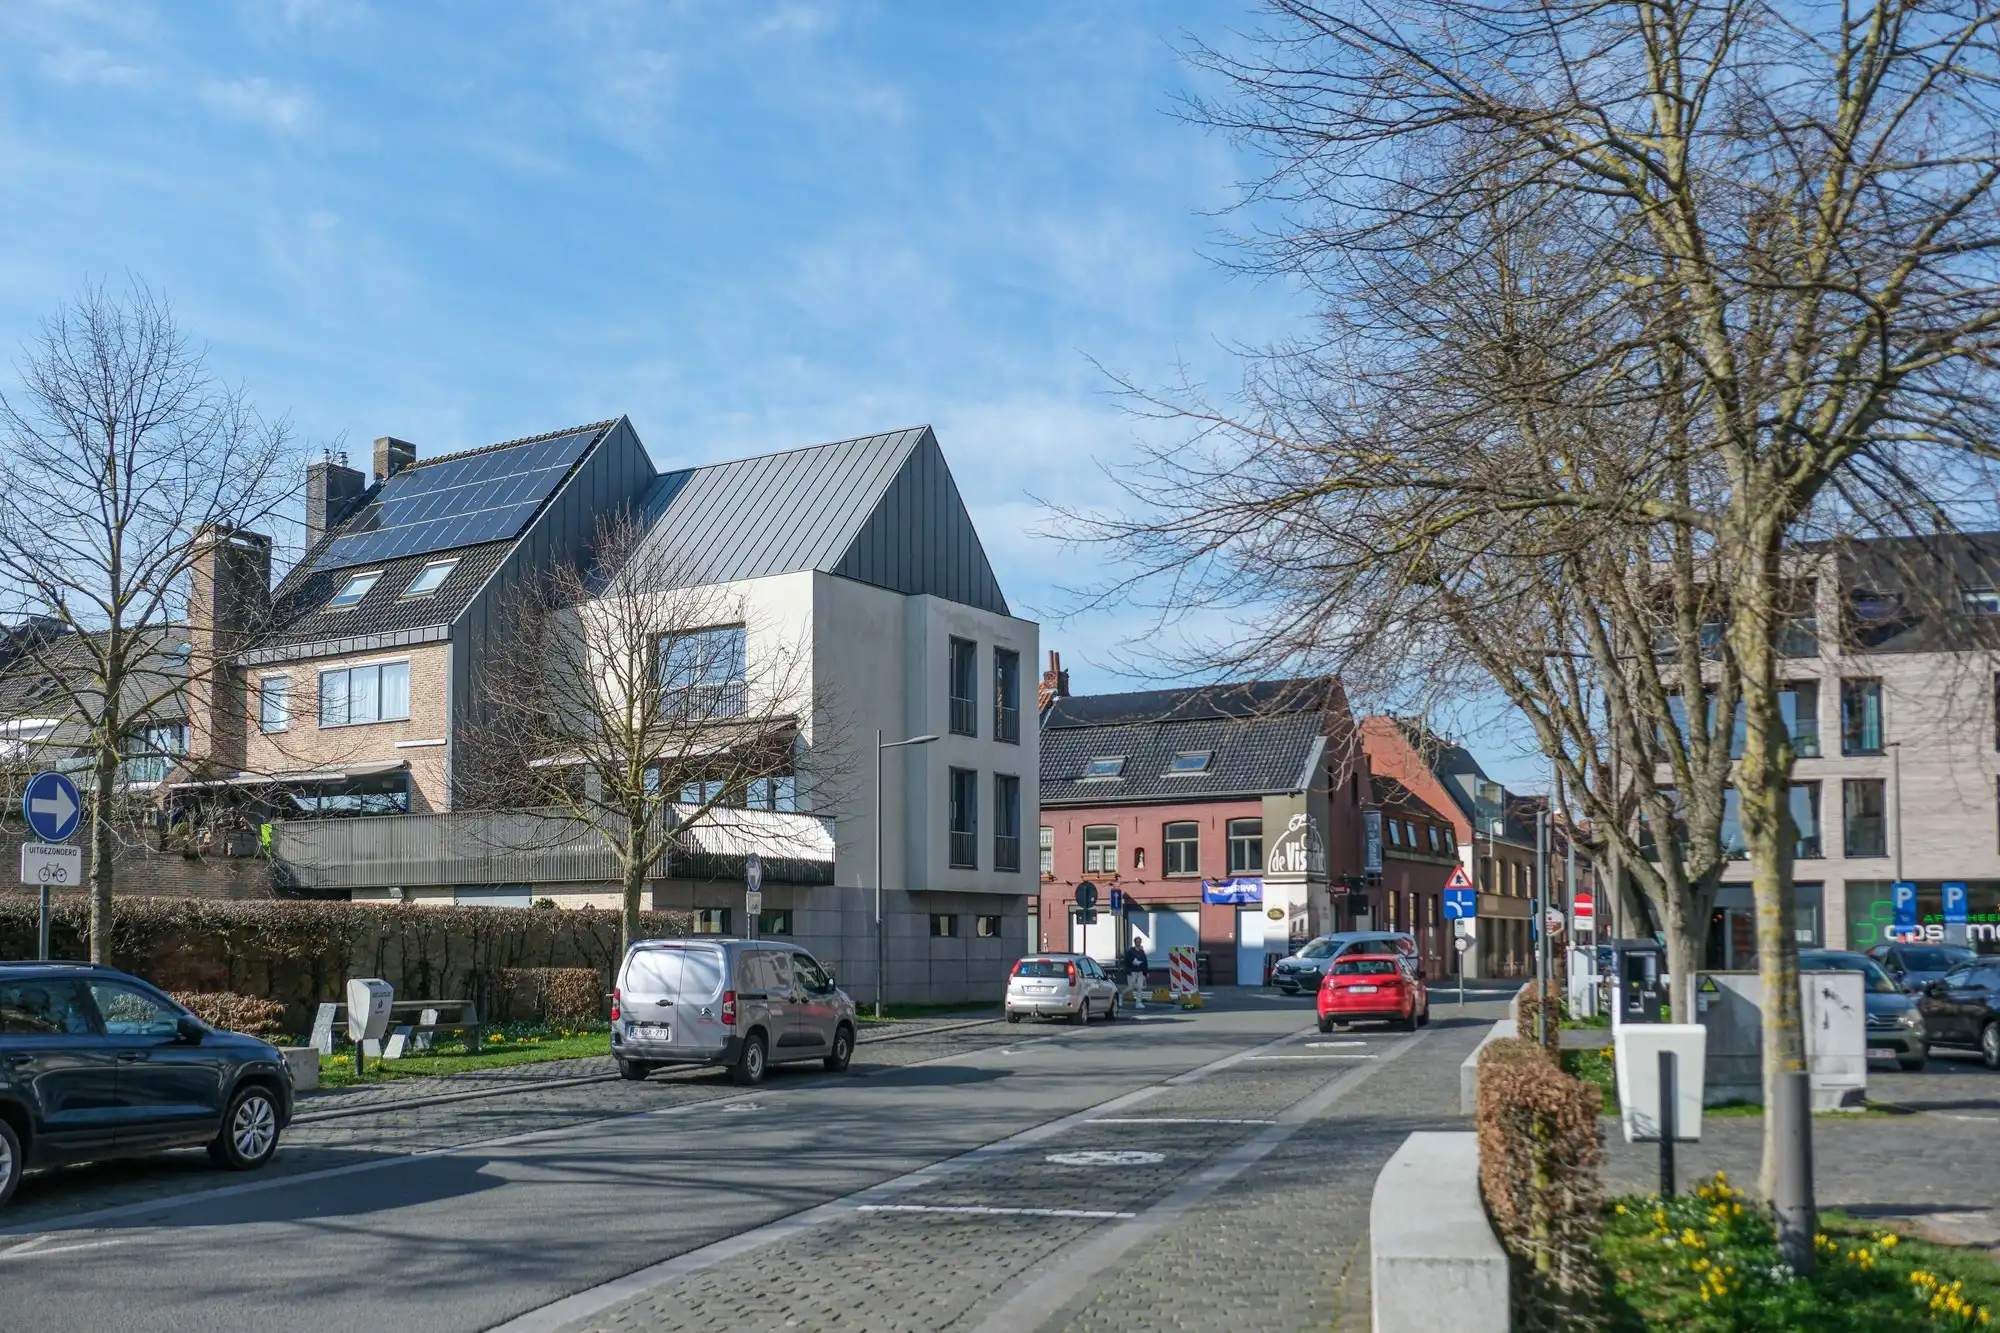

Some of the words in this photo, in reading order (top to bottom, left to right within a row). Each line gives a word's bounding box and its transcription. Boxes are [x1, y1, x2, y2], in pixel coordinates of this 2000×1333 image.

[29, 846, 77, 857] UITGEZONDERD
[1896, 887, 1912, 909] P
[1947, 887, 1963, 909] P
